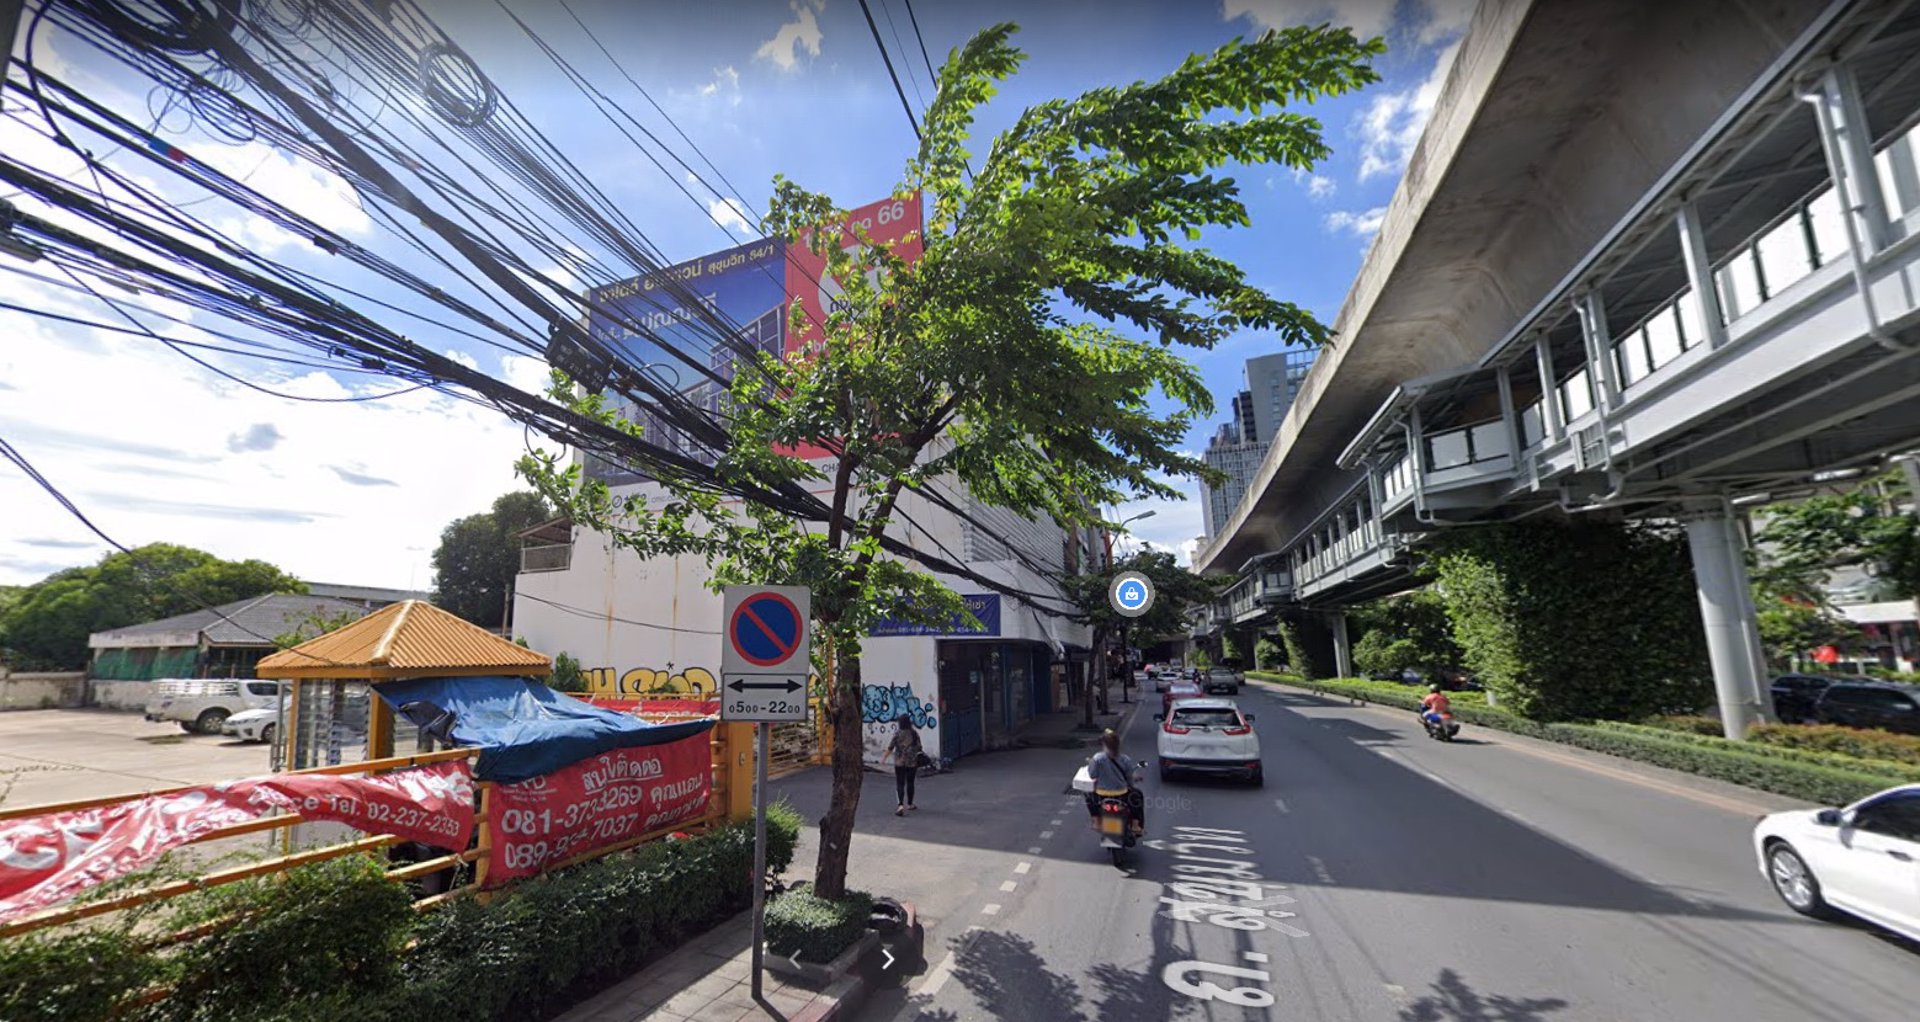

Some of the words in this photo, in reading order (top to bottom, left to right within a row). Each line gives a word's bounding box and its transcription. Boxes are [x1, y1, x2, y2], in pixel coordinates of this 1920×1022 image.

[877, 201, 905, 225] 66
[707, 253, 746, 275] สุขุมวิท
[326, 793, 361, 816] Tel.
[367, 801, 461, 837] 02-237-2353
